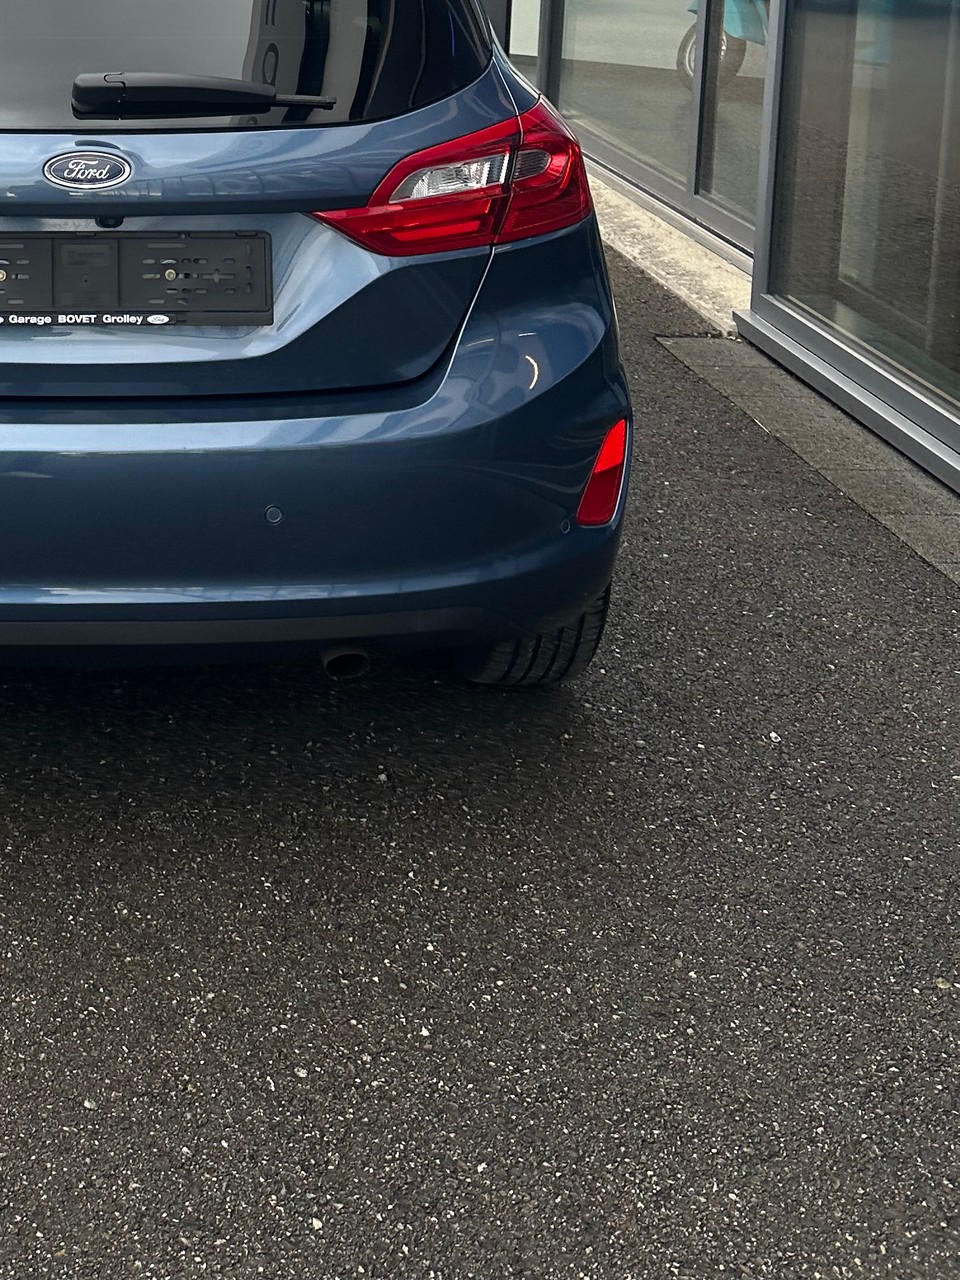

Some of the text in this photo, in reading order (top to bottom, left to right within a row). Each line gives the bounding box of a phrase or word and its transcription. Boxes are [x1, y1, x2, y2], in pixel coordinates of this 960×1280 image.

[63, 159, 111, 179] Ford
[8, 314, 52, 325] Garage
[58, 314, 97, 324] BOVET
[102, 314, 144, 325] Grolley
